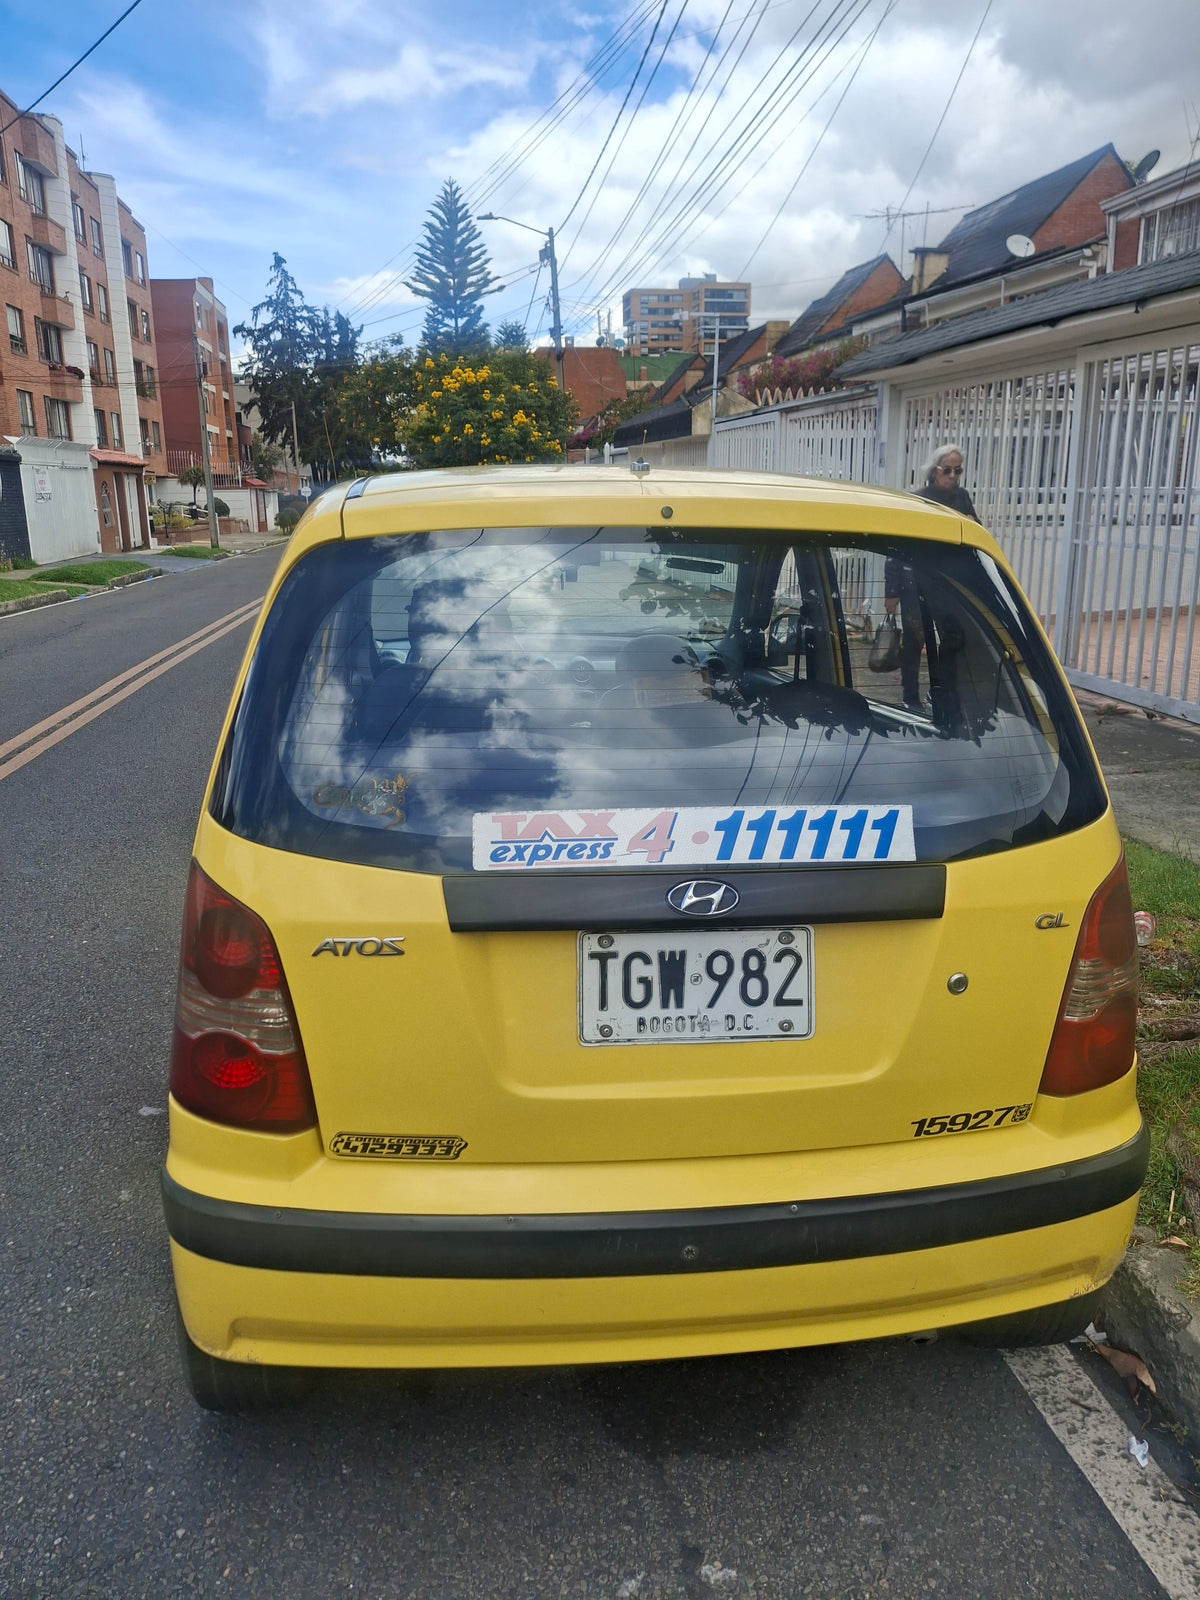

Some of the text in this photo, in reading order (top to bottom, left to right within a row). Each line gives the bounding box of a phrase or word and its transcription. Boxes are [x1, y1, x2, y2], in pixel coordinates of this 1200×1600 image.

[489, 841, 616, 867] express
[1035, 912, 1070, 930] GL
[311, 936, 406, 957] ATOS
[587, 947, 804, 1012] TGW 982
[724, 1013, 760, 1031] D.C.
[911, 1105, 1017, 1138] 15927
